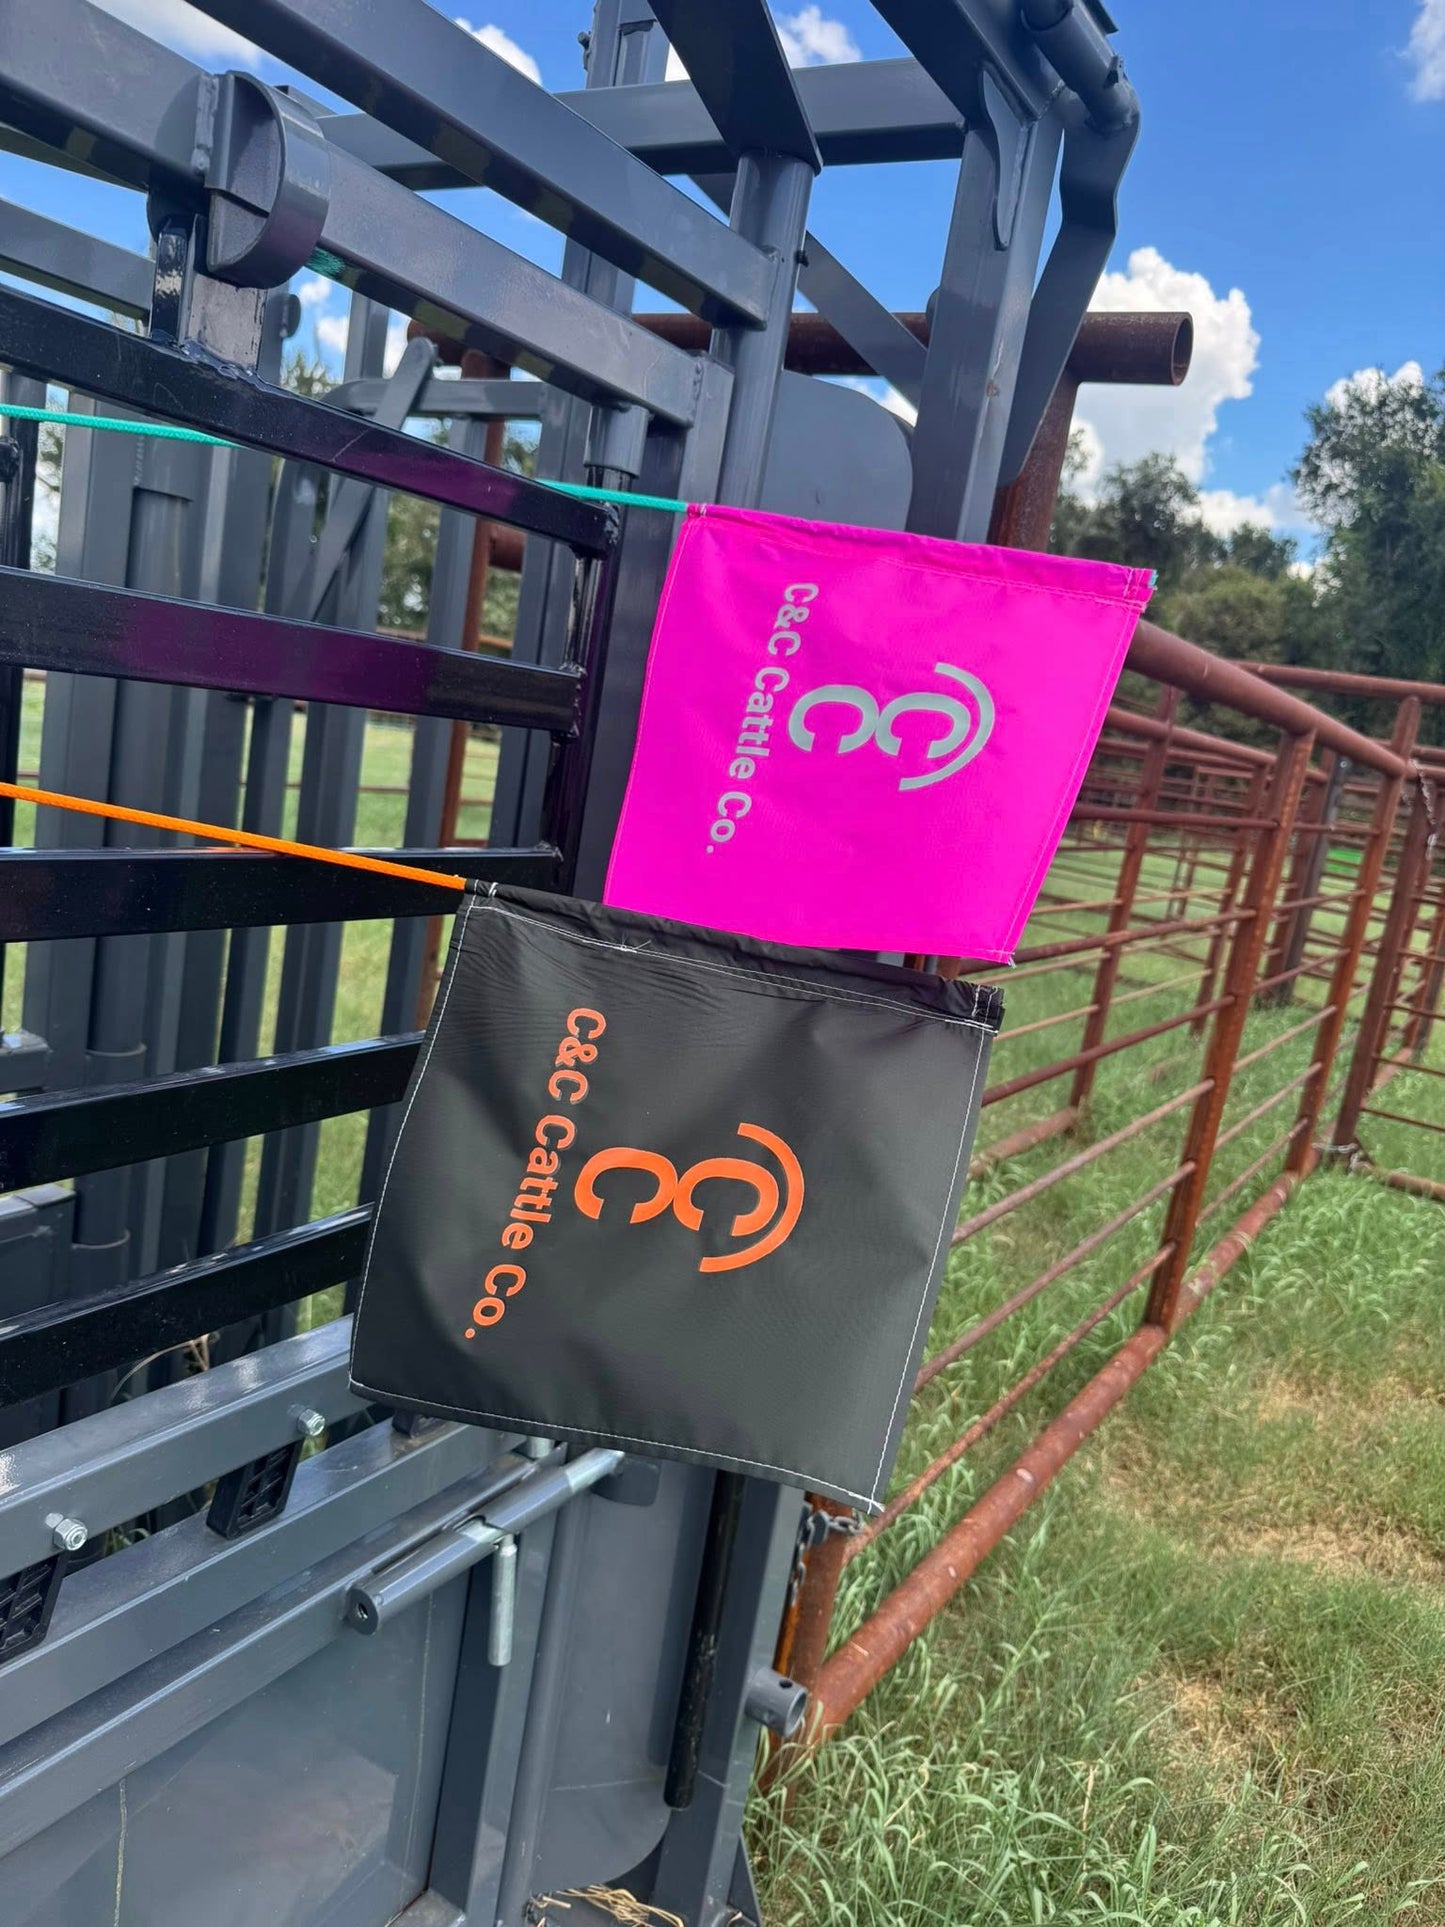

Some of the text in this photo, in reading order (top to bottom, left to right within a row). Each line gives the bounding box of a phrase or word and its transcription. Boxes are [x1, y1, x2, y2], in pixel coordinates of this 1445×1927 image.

[706, 583, 819, 854] C&C Cattle Co.
[464, 1007, 606, 1339] C&C Cattle Co.
